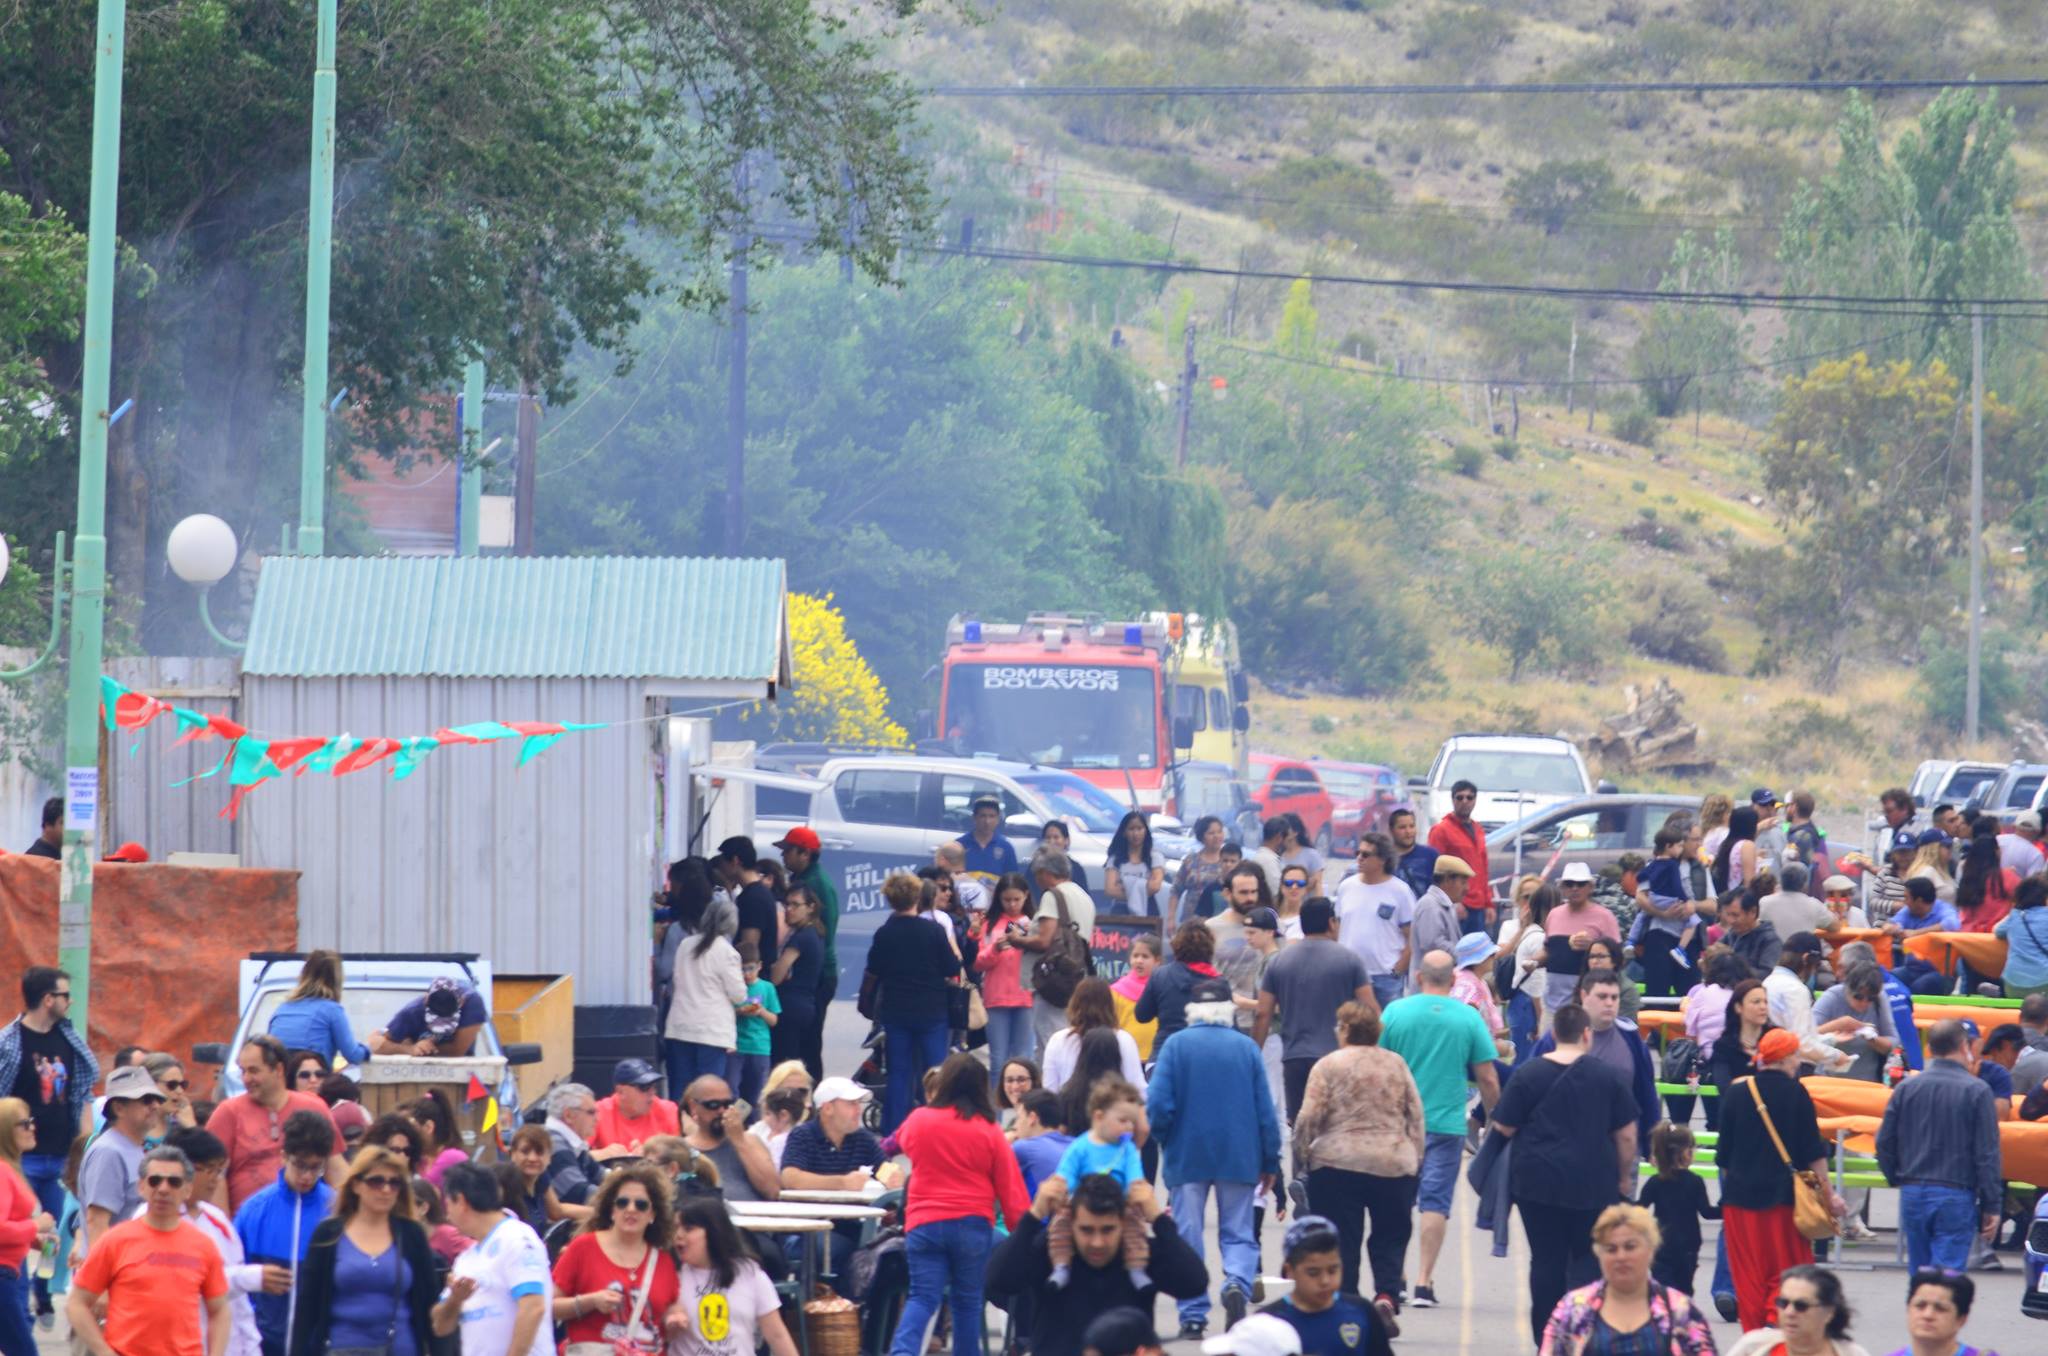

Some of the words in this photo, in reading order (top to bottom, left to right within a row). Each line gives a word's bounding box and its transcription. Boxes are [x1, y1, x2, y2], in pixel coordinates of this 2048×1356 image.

[983, 667, 1119, 680] BOMBEROS
[983, 678, 1119, 691] DOLAVON
[845, 864, 917, 890] HIL
[846, 889, 885, 912] AUT
